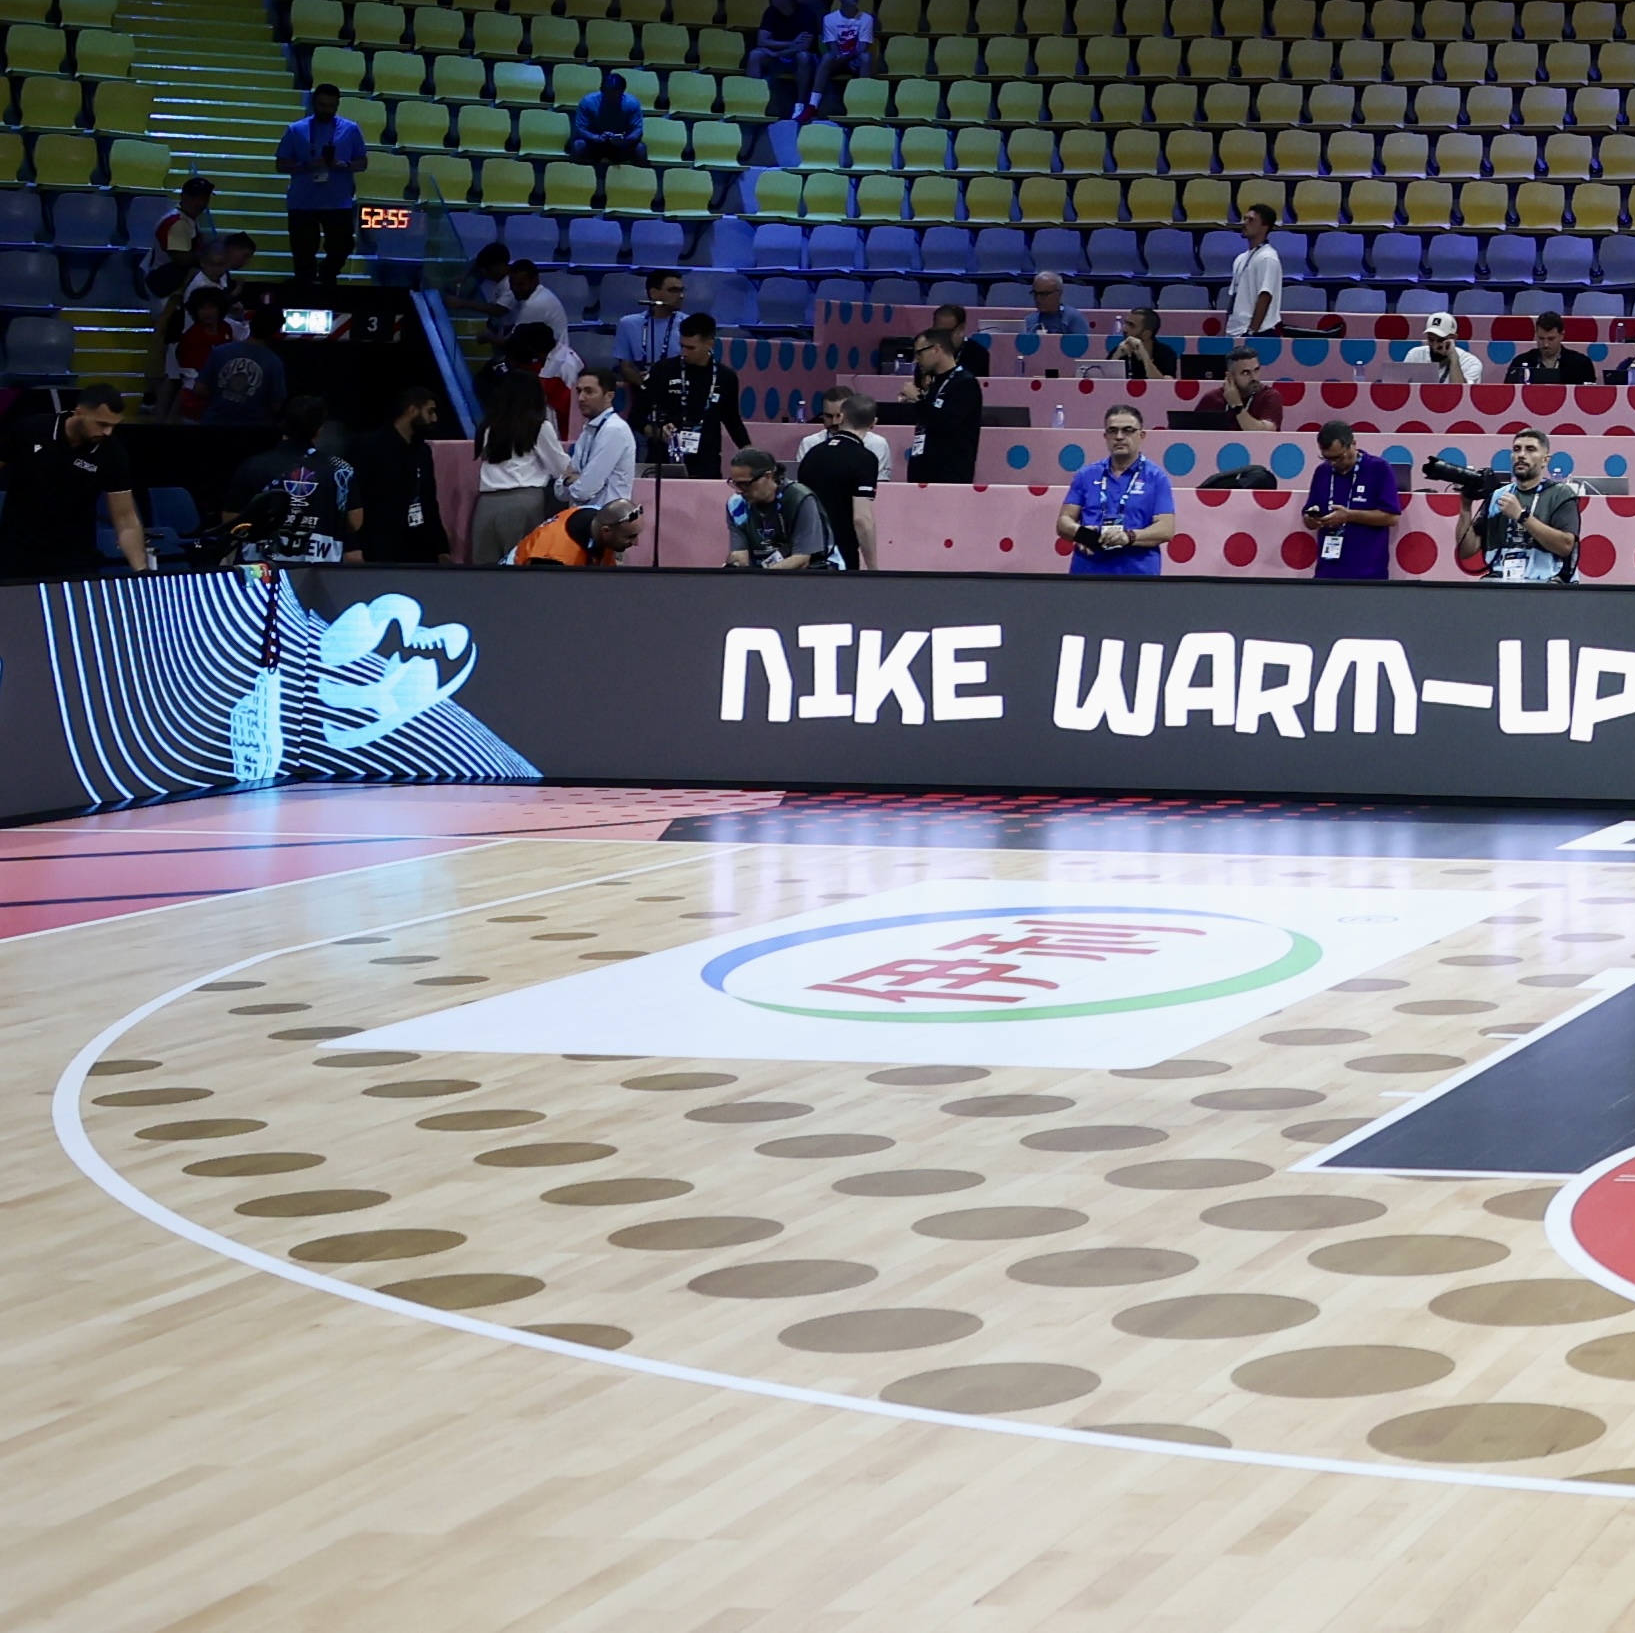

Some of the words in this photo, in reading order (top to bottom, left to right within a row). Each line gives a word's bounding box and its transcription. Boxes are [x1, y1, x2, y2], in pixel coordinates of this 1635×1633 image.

[367, 316, 378, 332] 3
[720, 623, 1004, 725] NIKE
[803, 919, 1208, 1005] 伊利
